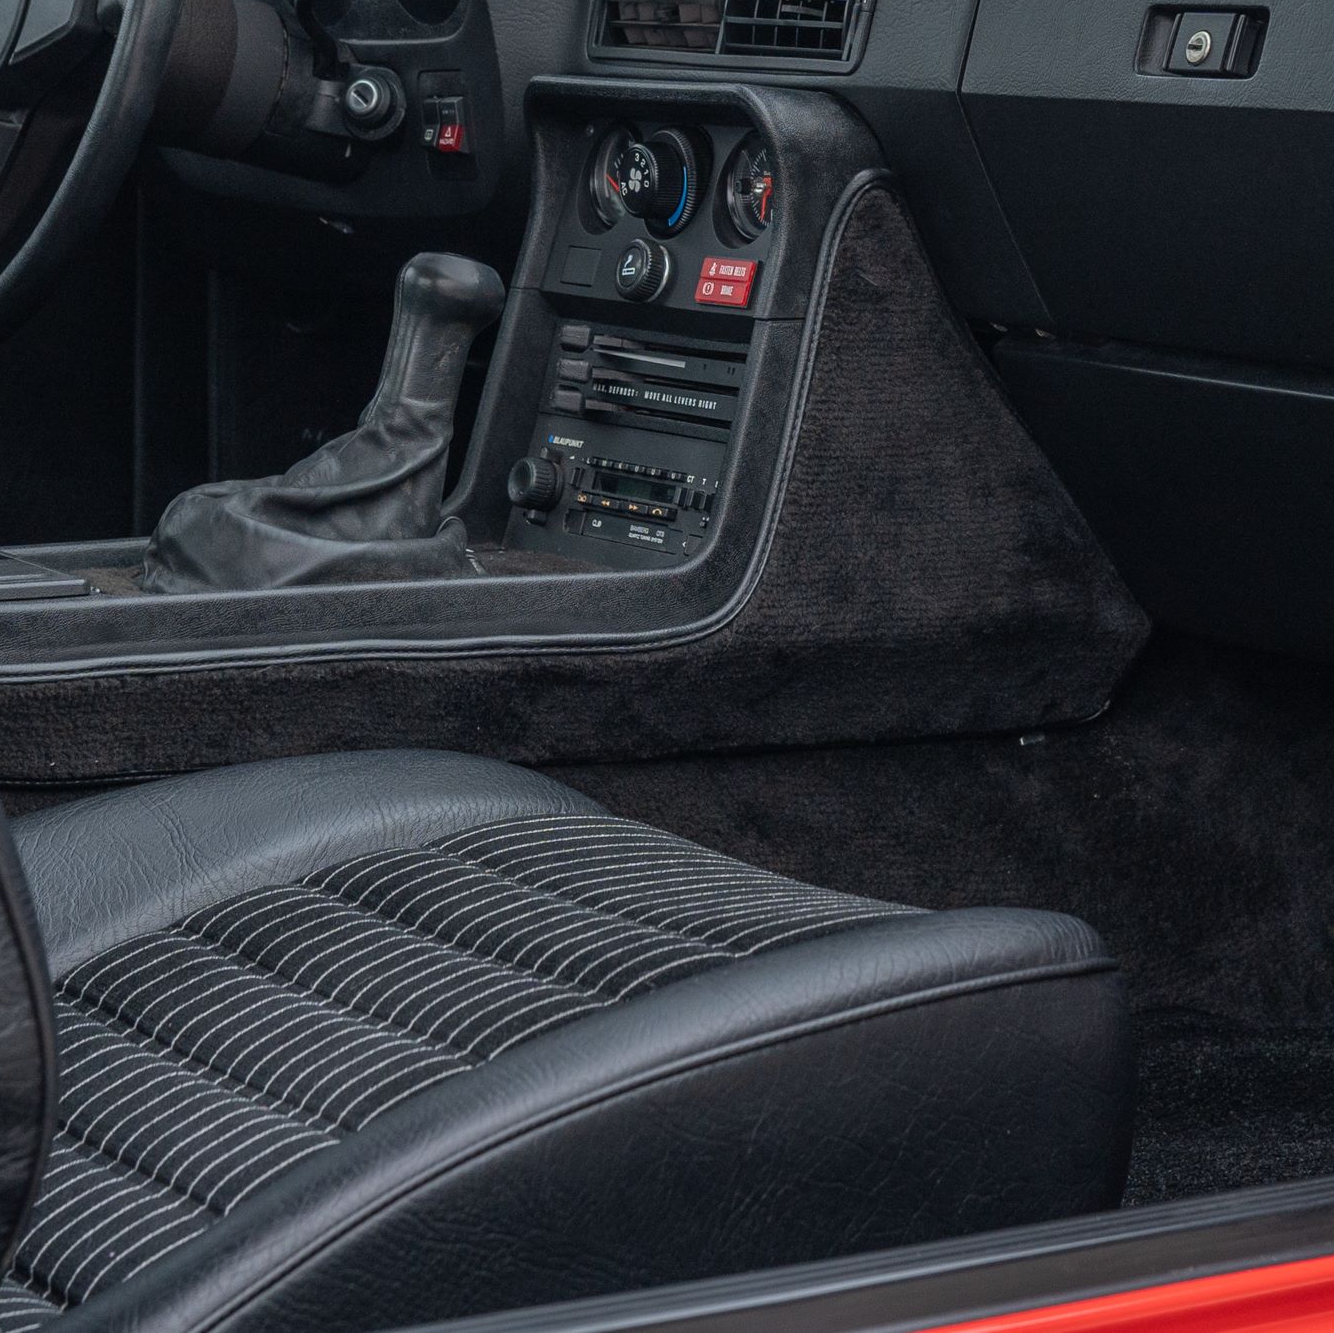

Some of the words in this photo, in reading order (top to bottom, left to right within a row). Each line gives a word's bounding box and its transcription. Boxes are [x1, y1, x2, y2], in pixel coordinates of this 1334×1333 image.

[634, 152, 640, 162] 3
[640, 158, 646, 168] 2
[620, 182, 628, 196] AC
[608, 385, 639, 397] DEFROST:
[644, 391, 661, 402] MOVE
[661, 393, 673, 403] ALL
[673, 396, 697, 407] LEVERS
[697, 399, 717, 410] RIGHT
[553, 435, 584, 449] BLAUPUNKT
